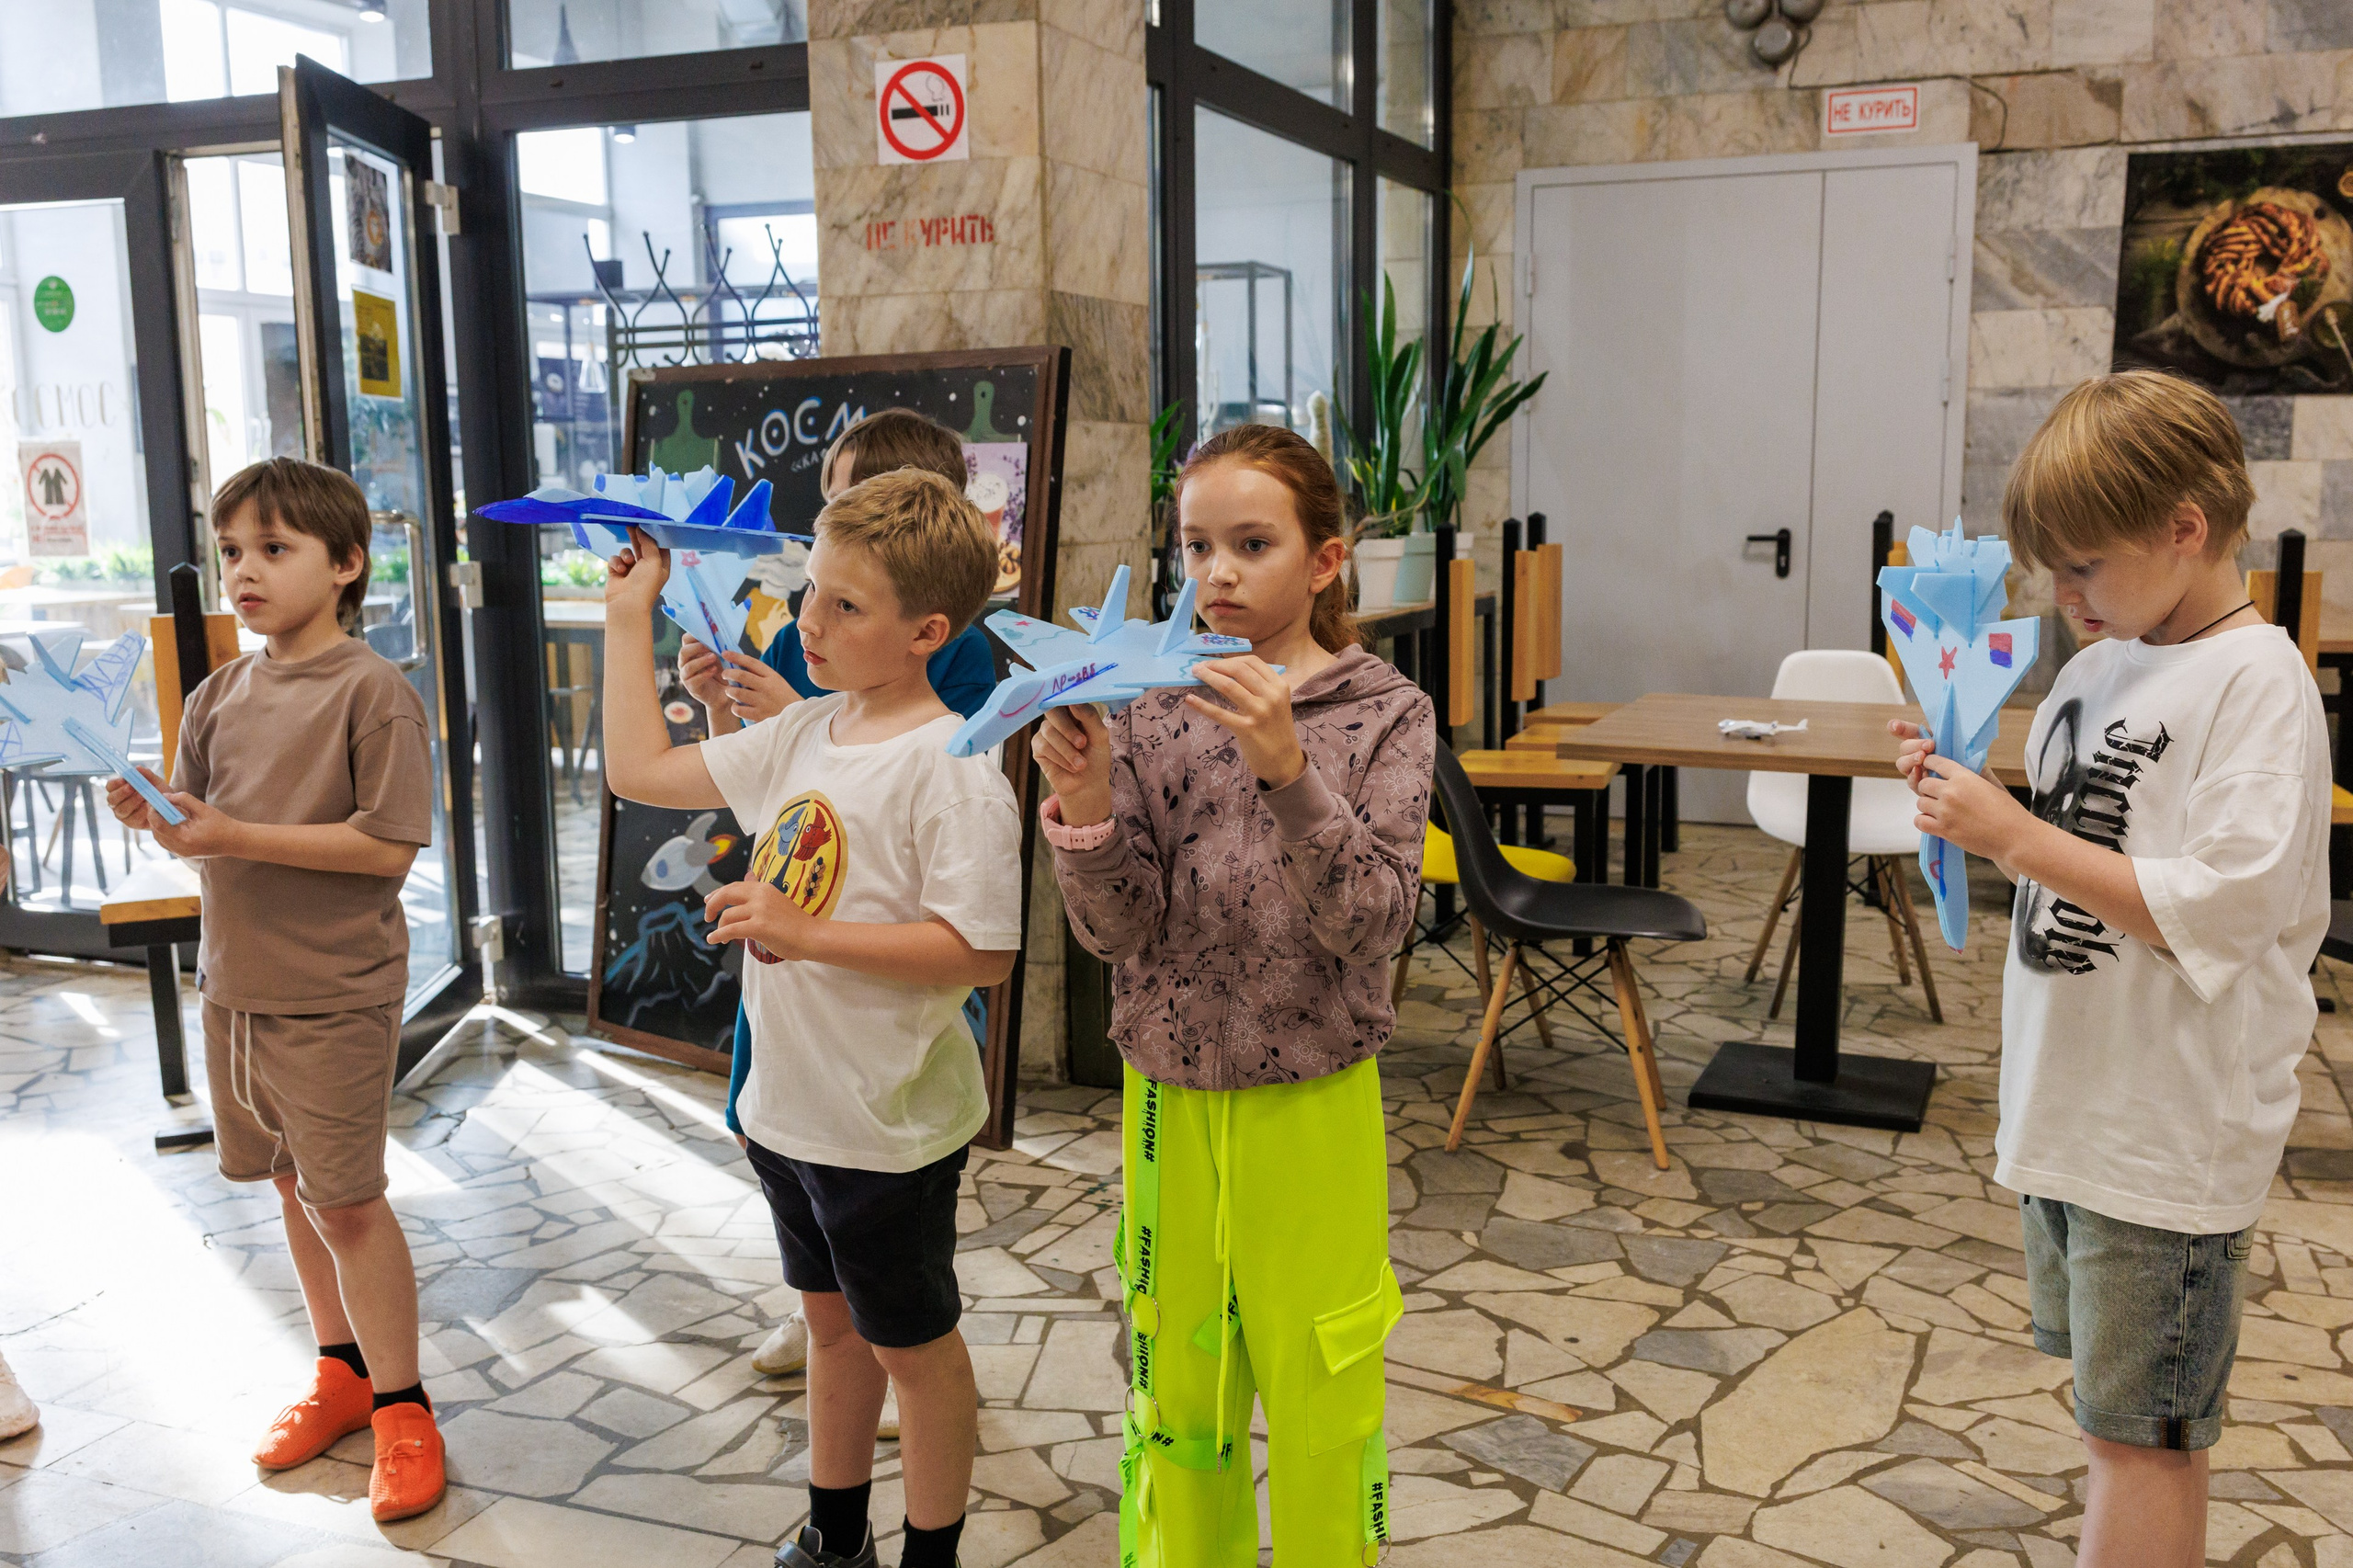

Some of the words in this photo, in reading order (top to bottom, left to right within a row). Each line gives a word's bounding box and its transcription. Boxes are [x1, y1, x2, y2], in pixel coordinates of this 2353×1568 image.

[1833, 102, 1851, 122] НЕ
[1859, 97, 1911, 120] КУРИТЬ
[2042, 717, 2175, 975] Incrble
